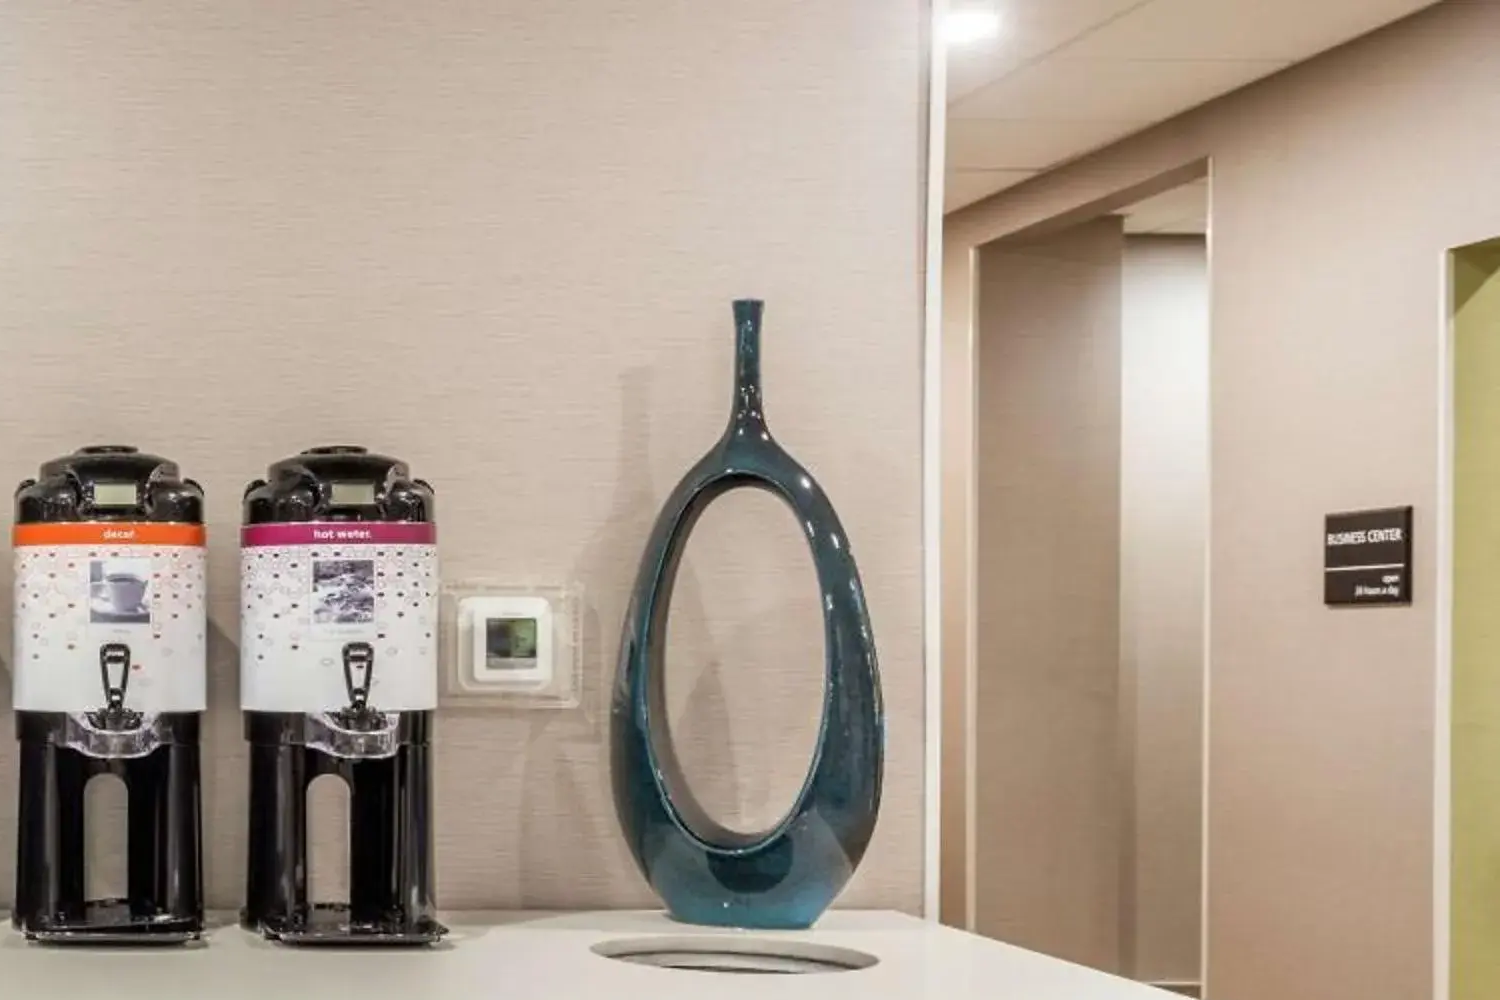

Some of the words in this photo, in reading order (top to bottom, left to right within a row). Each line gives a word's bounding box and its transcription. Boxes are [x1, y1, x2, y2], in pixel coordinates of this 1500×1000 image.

[313, 529, 335, 539] hot
[1327, 530, 1367, 546] BUSINESS
[1367, 527, 1402, 543] CENTER
